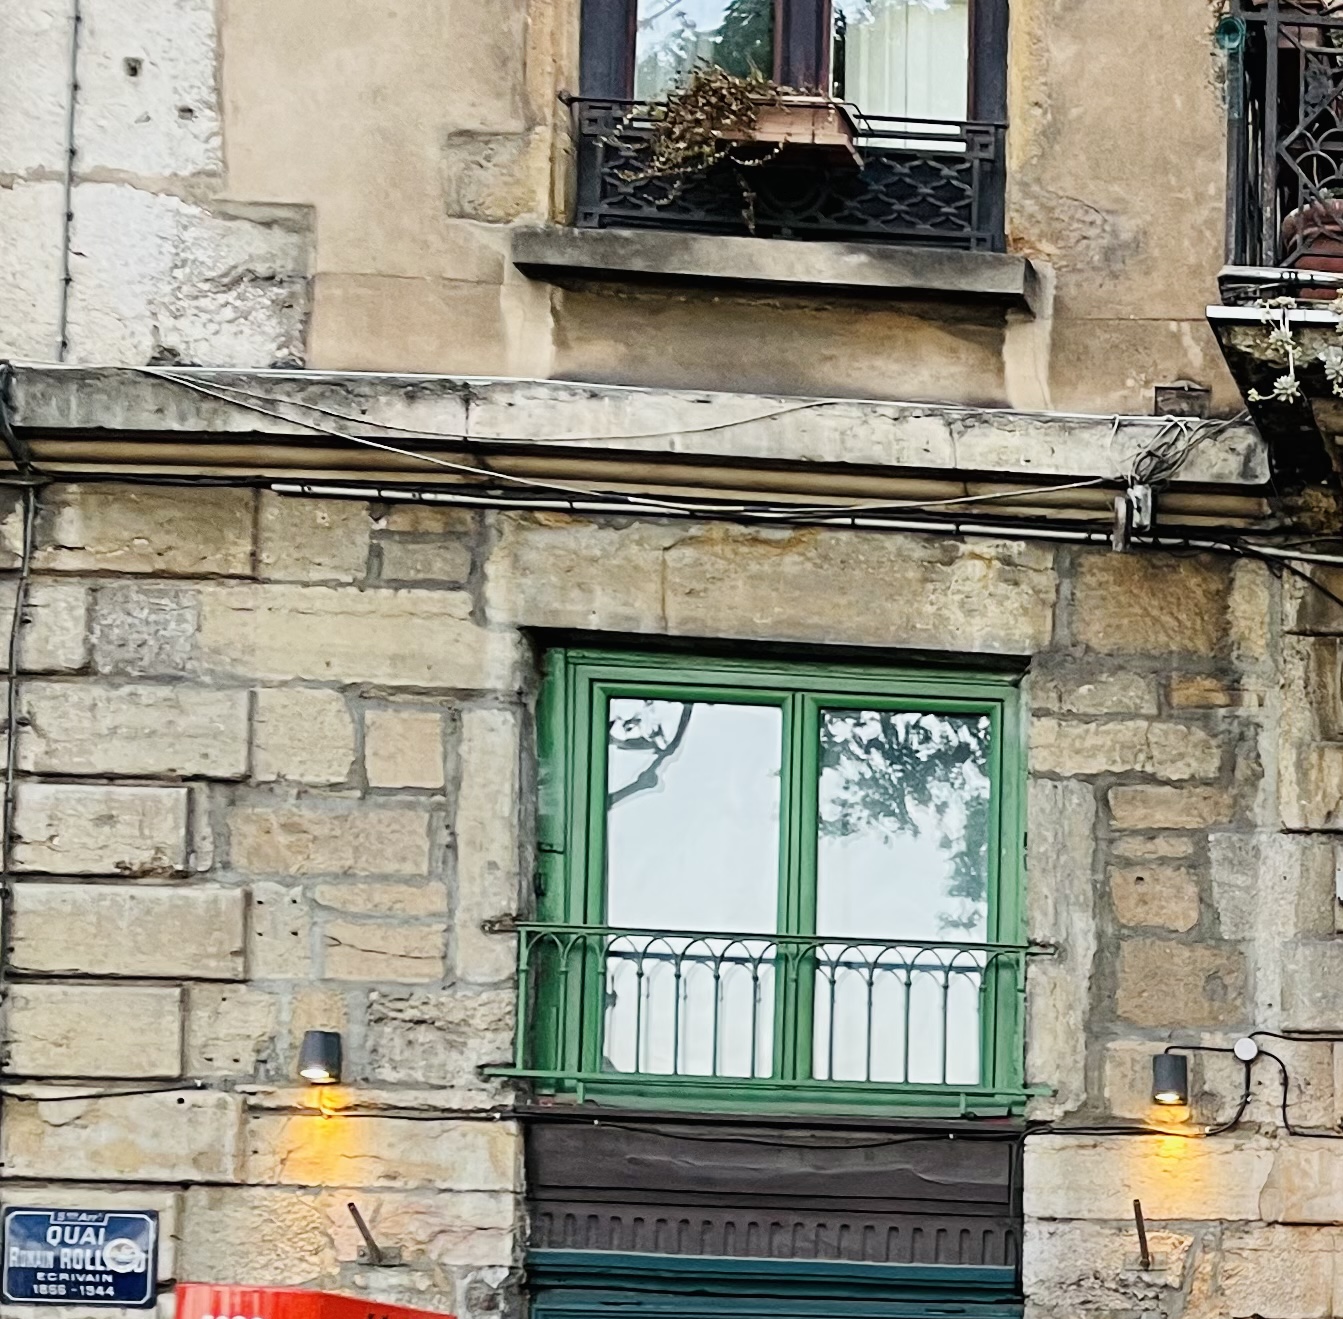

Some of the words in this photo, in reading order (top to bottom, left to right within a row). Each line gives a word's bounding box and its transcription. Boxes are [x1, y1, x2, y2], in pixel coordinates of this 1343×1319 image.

[46, 1226, 106, 1247] QUAI
[60, 1248, 147, 1274] ROLLD
[36, 1272, 114, 1283] ECRIVAIN
